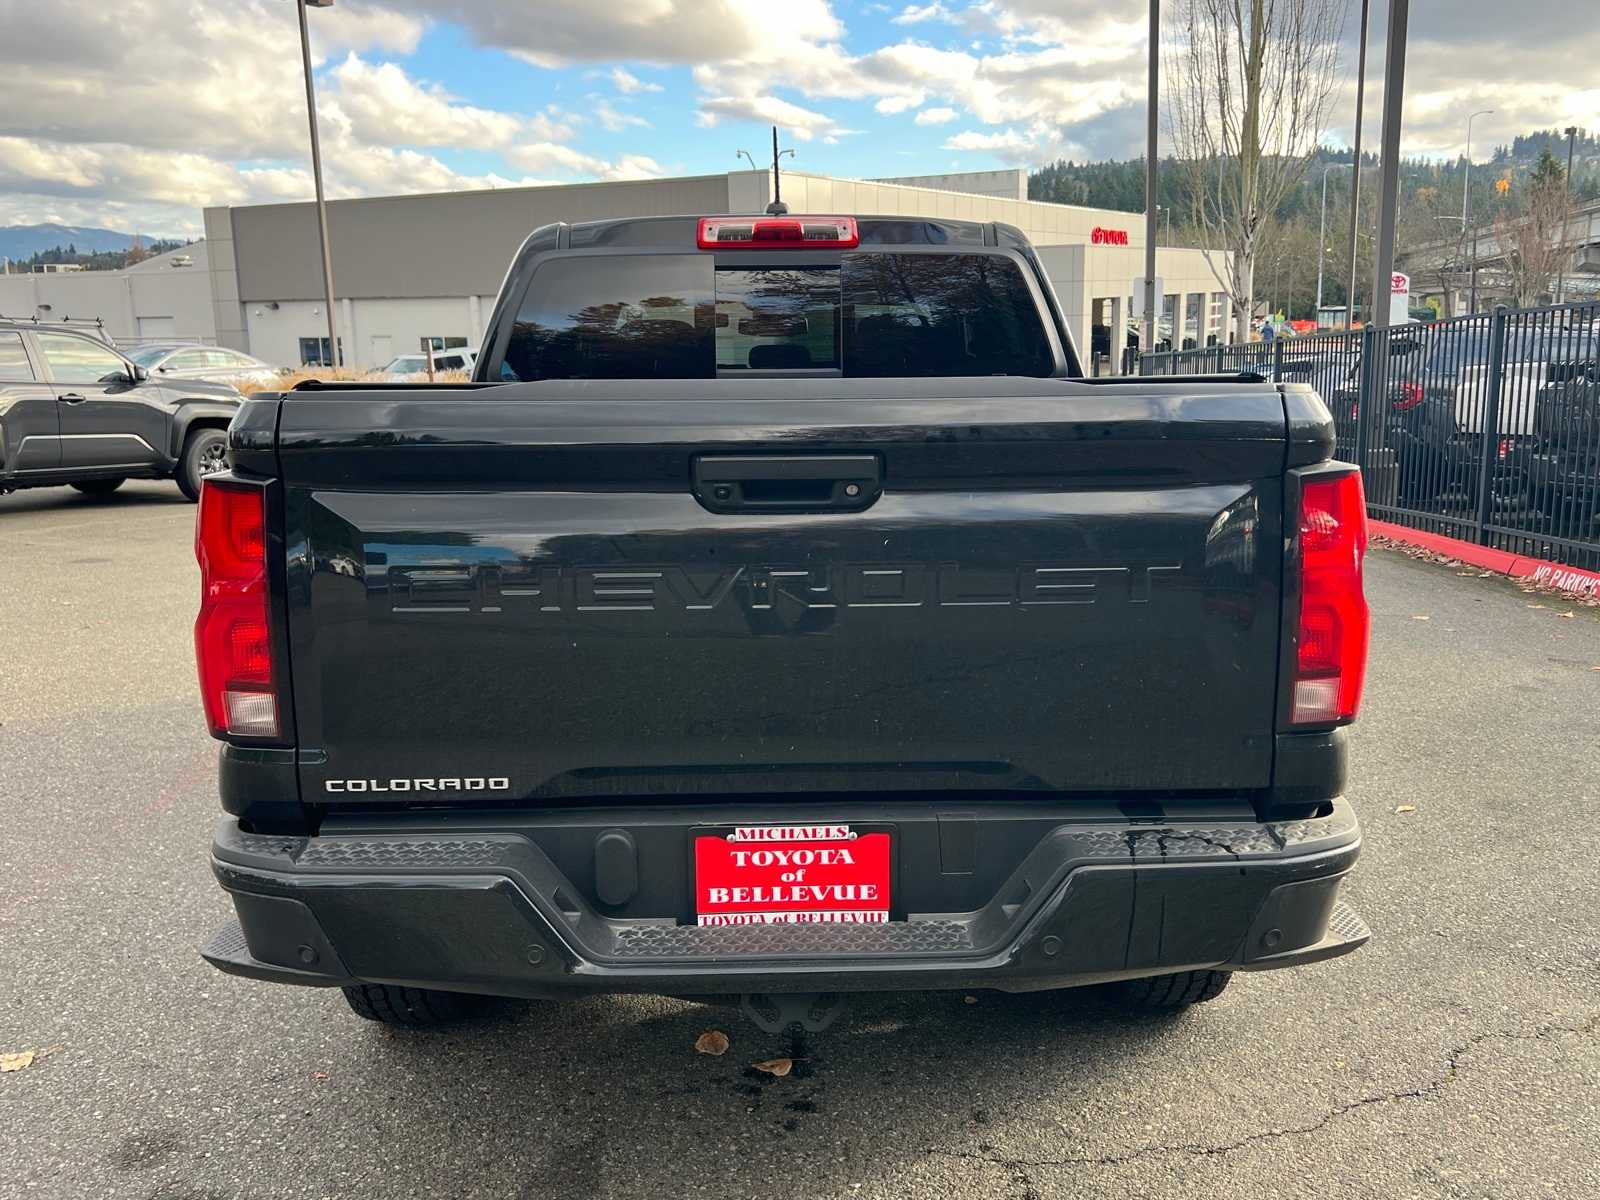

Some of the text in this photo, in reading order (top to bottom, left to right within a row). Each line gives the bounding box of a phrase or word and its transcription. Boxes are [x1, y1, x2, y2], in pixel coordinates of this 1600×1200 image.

[1102, 229, 1128, 245] TOYOTA
[389, 561, 1182, 611] CHEVROLET
[325, 777, 510, 792] COLORADO
[738, 826, 848, 840] MICHAELS
[730, 848, 856, 867] TOYOTA
[780, 868, 806, 882] of
[707, 884, 879, 904] BELLEVUE
[699, 913, 766, 928] TOYOTA
